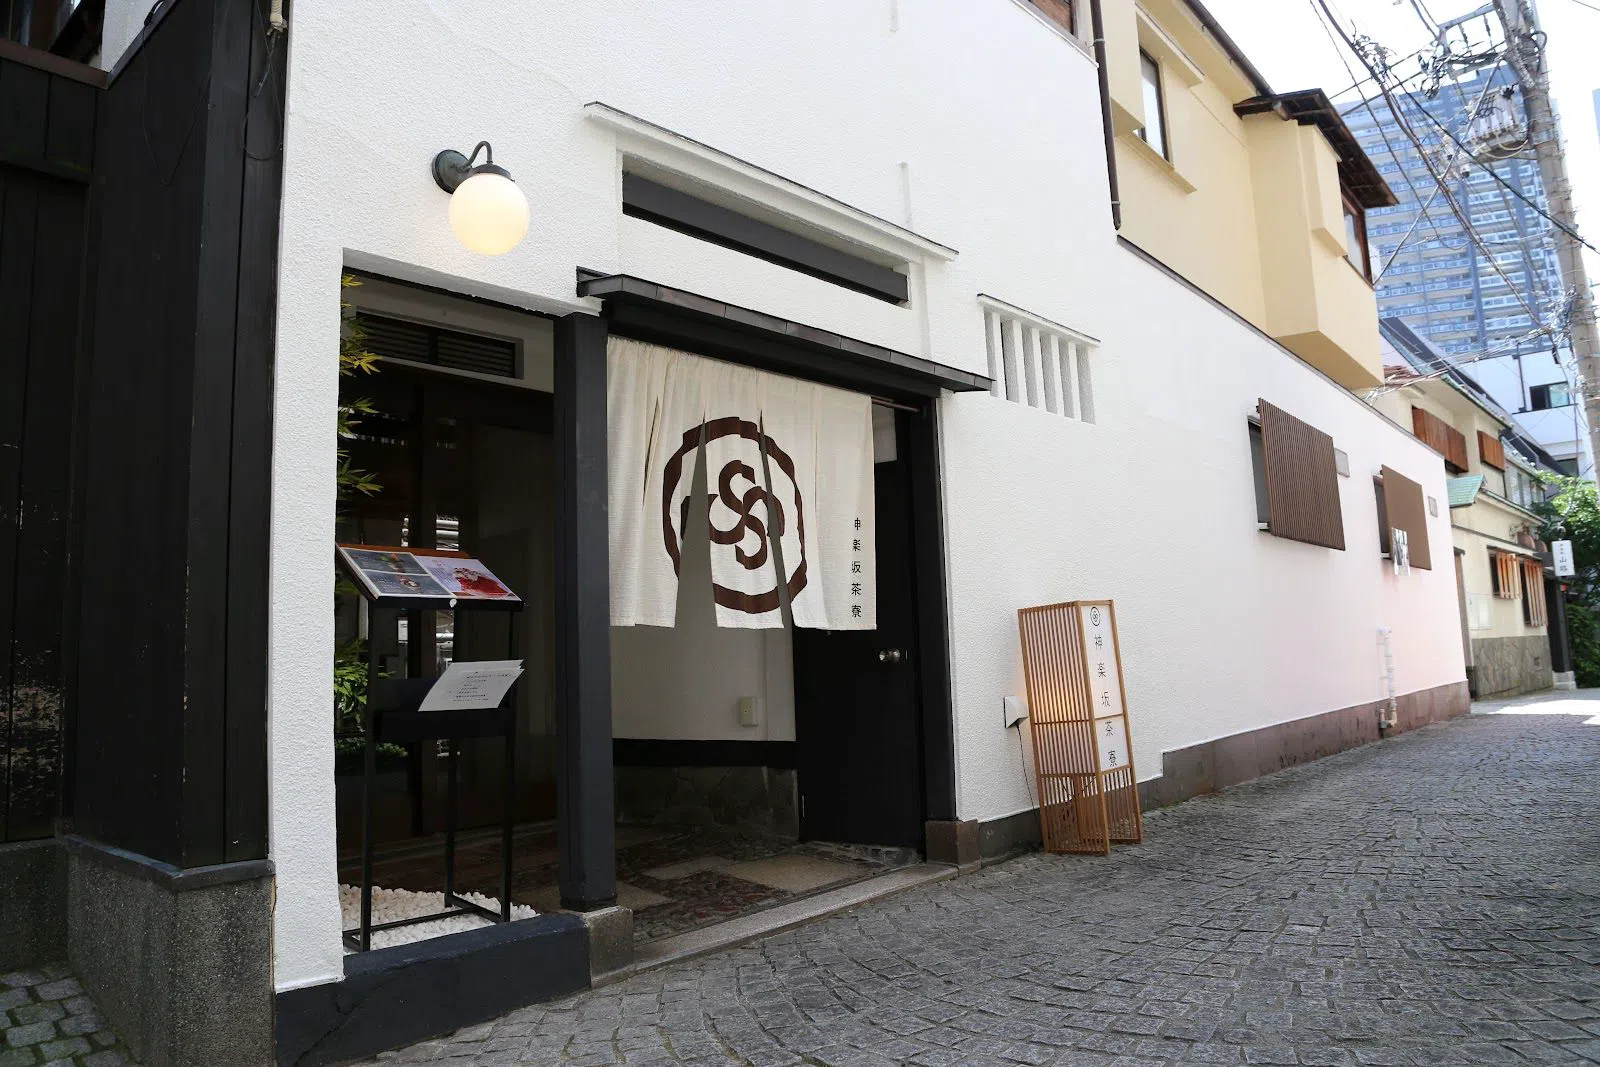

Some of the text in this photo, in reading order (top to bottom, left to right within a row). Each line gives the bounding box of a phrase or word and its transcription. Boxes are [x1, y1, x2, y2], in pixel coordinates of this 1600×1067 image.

[1094, 634, 1118, 767] 神楽坂茶寮
